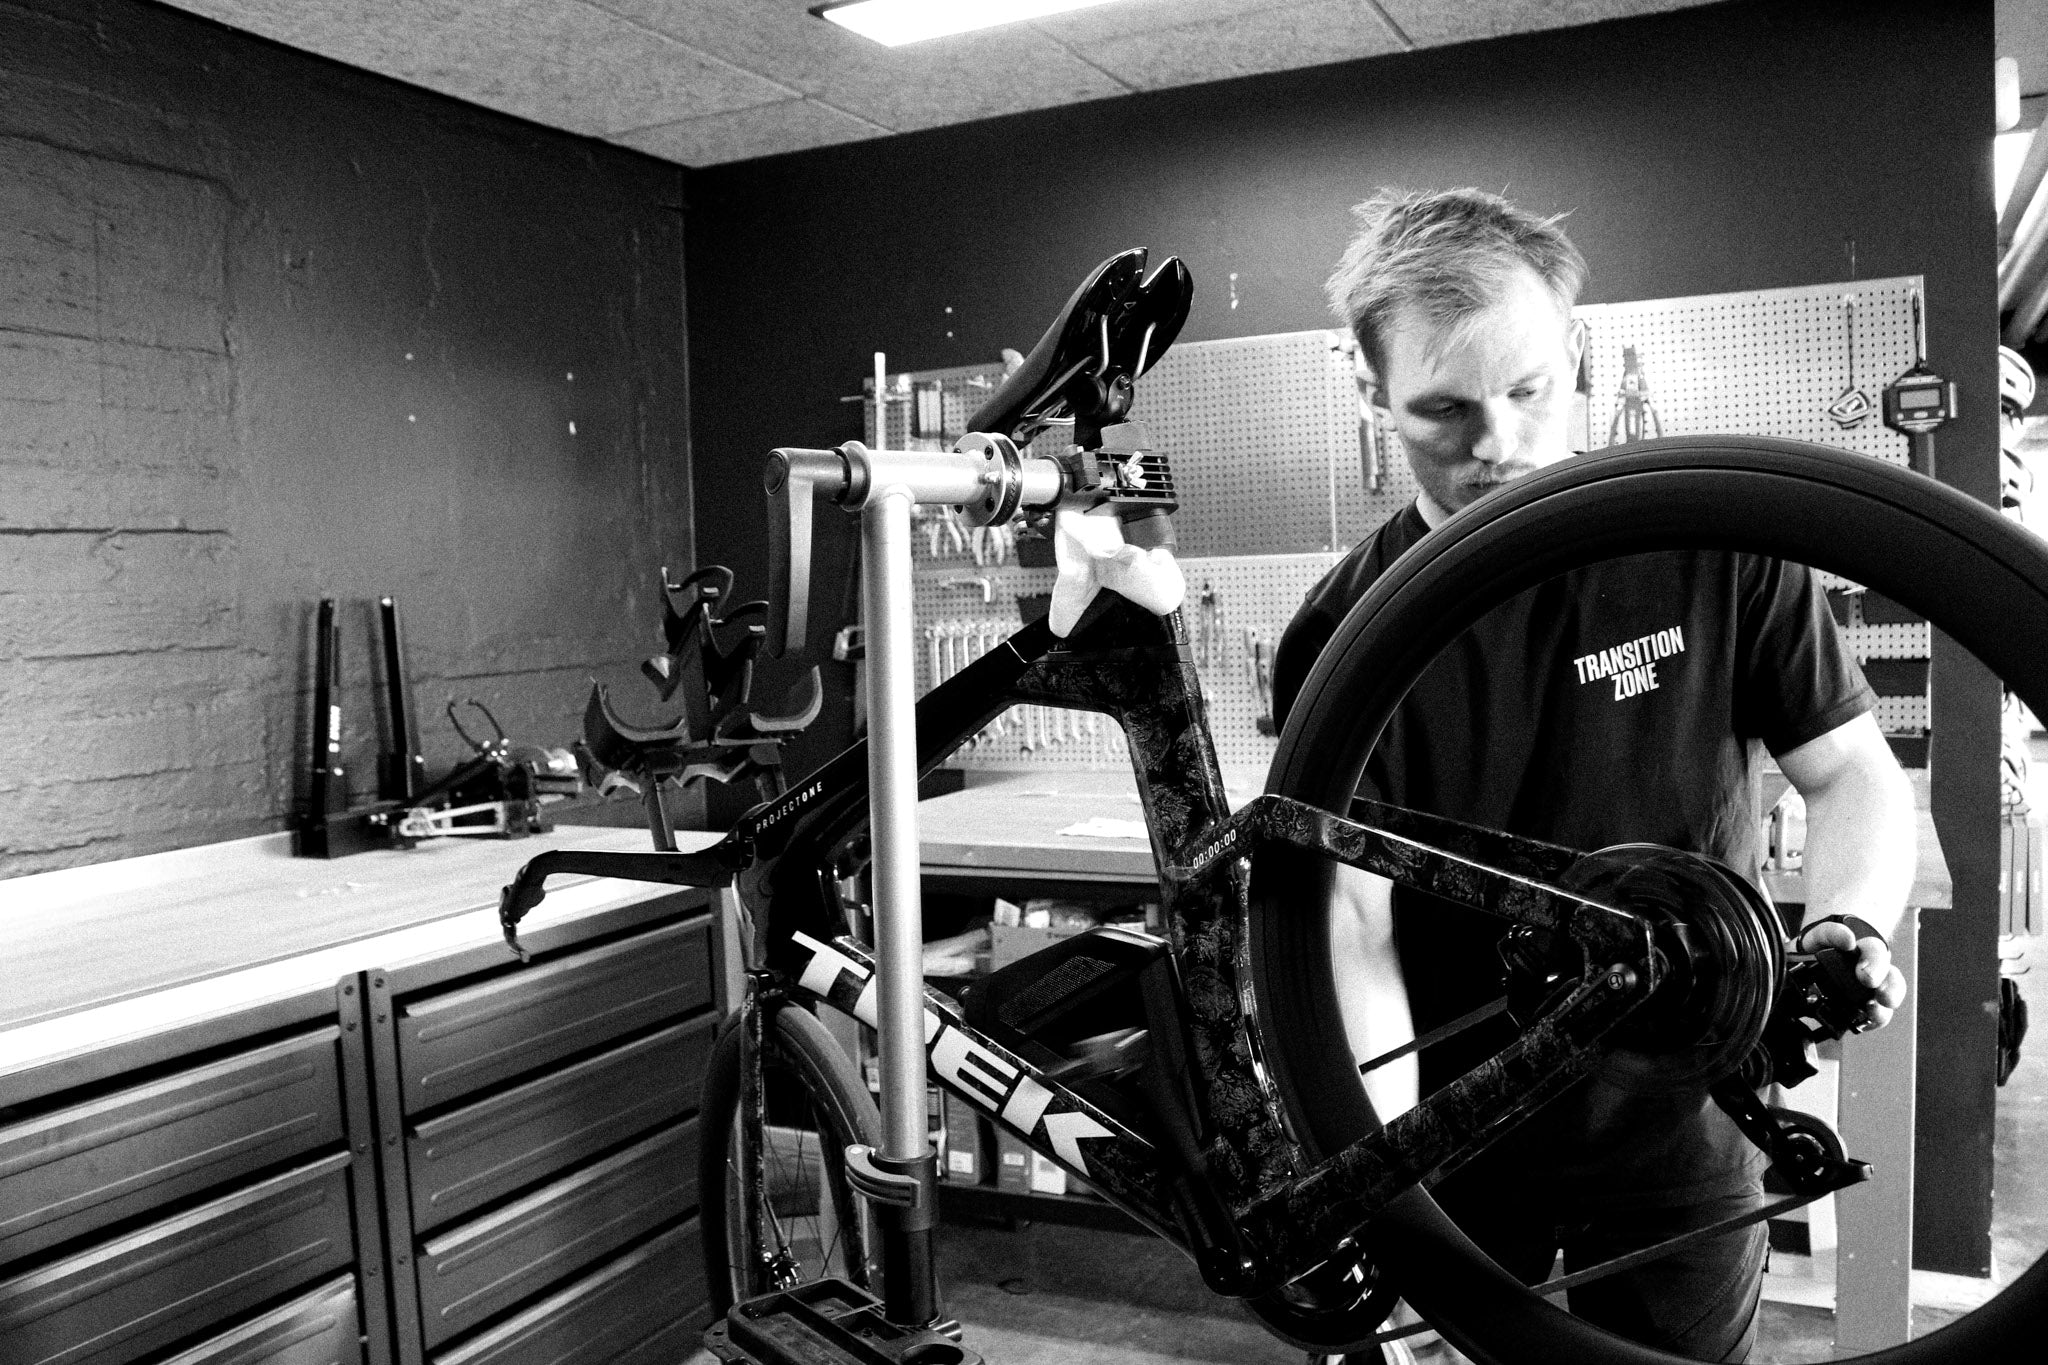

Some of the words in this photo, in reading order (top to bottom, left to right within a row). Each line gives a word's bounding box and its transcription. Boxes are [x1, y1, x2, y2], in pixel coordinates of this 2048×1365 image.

[1574, 626, 1685, 685] TRANSITION
[1611, 662, 1660, 701] ZONE
[1193, 829, 1236, 869] 00:00:00
